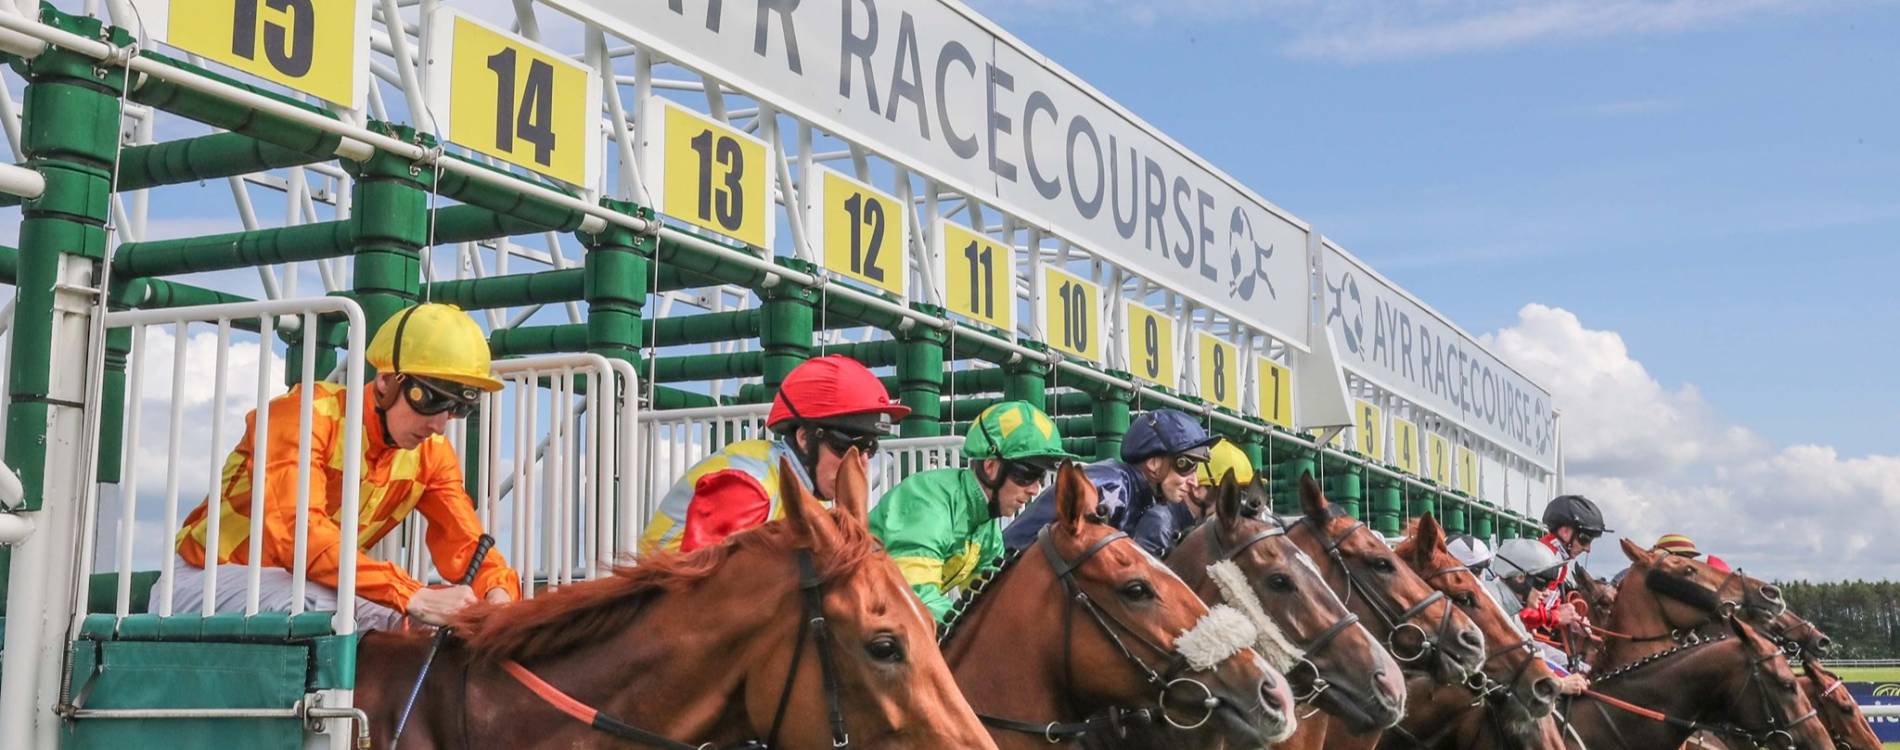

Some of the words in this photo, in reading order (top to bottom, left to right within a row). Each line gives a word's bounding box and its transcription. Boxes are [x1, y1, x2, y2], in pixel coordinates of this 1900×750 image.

[486, 47, 556, 168] 14
[839, 0, 1218, 282] RACECOURSE
[691, 129, 744, 231] 13
[843, 192, 885, 283] 12
[964, 239, 994, 318] 11
[1059, 280, 1087, 352] 10
[1145, 315, 1158, 378] 9
[1213, 343, 1225, 401] 8
[1271, 366, 1279, 420] 7
[1373, 296, 1415, 382] AYR
[1420, 324, 1529, 447] RACECOURSE
[1365, 407, 1373, 454] 5
[1403, 425, 1410, 469] 4
[1436, 440, 1443, 481] 2
[1466, 453, 1471, 492] 1
